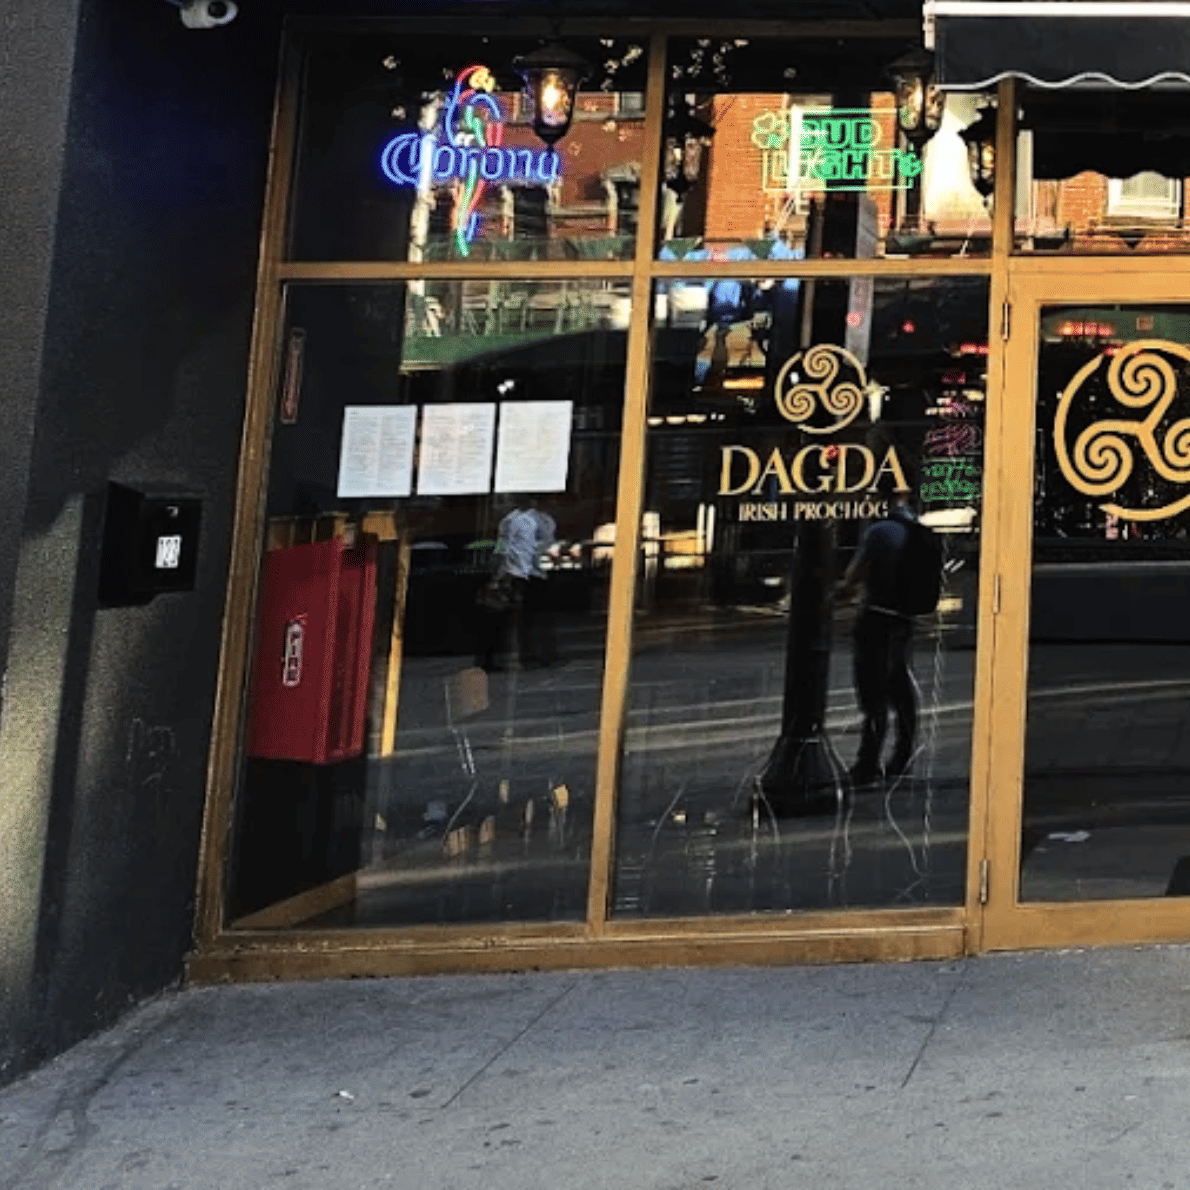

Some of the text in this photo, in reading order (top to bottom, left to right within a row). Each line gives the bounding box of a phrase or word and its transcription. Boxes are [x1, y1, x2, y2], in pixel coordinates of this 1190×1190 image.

[381, 132, 559, 185] Corona
[717, 443, 912, 495] DAGDA
[739, 501, 788, 522] IRISH
